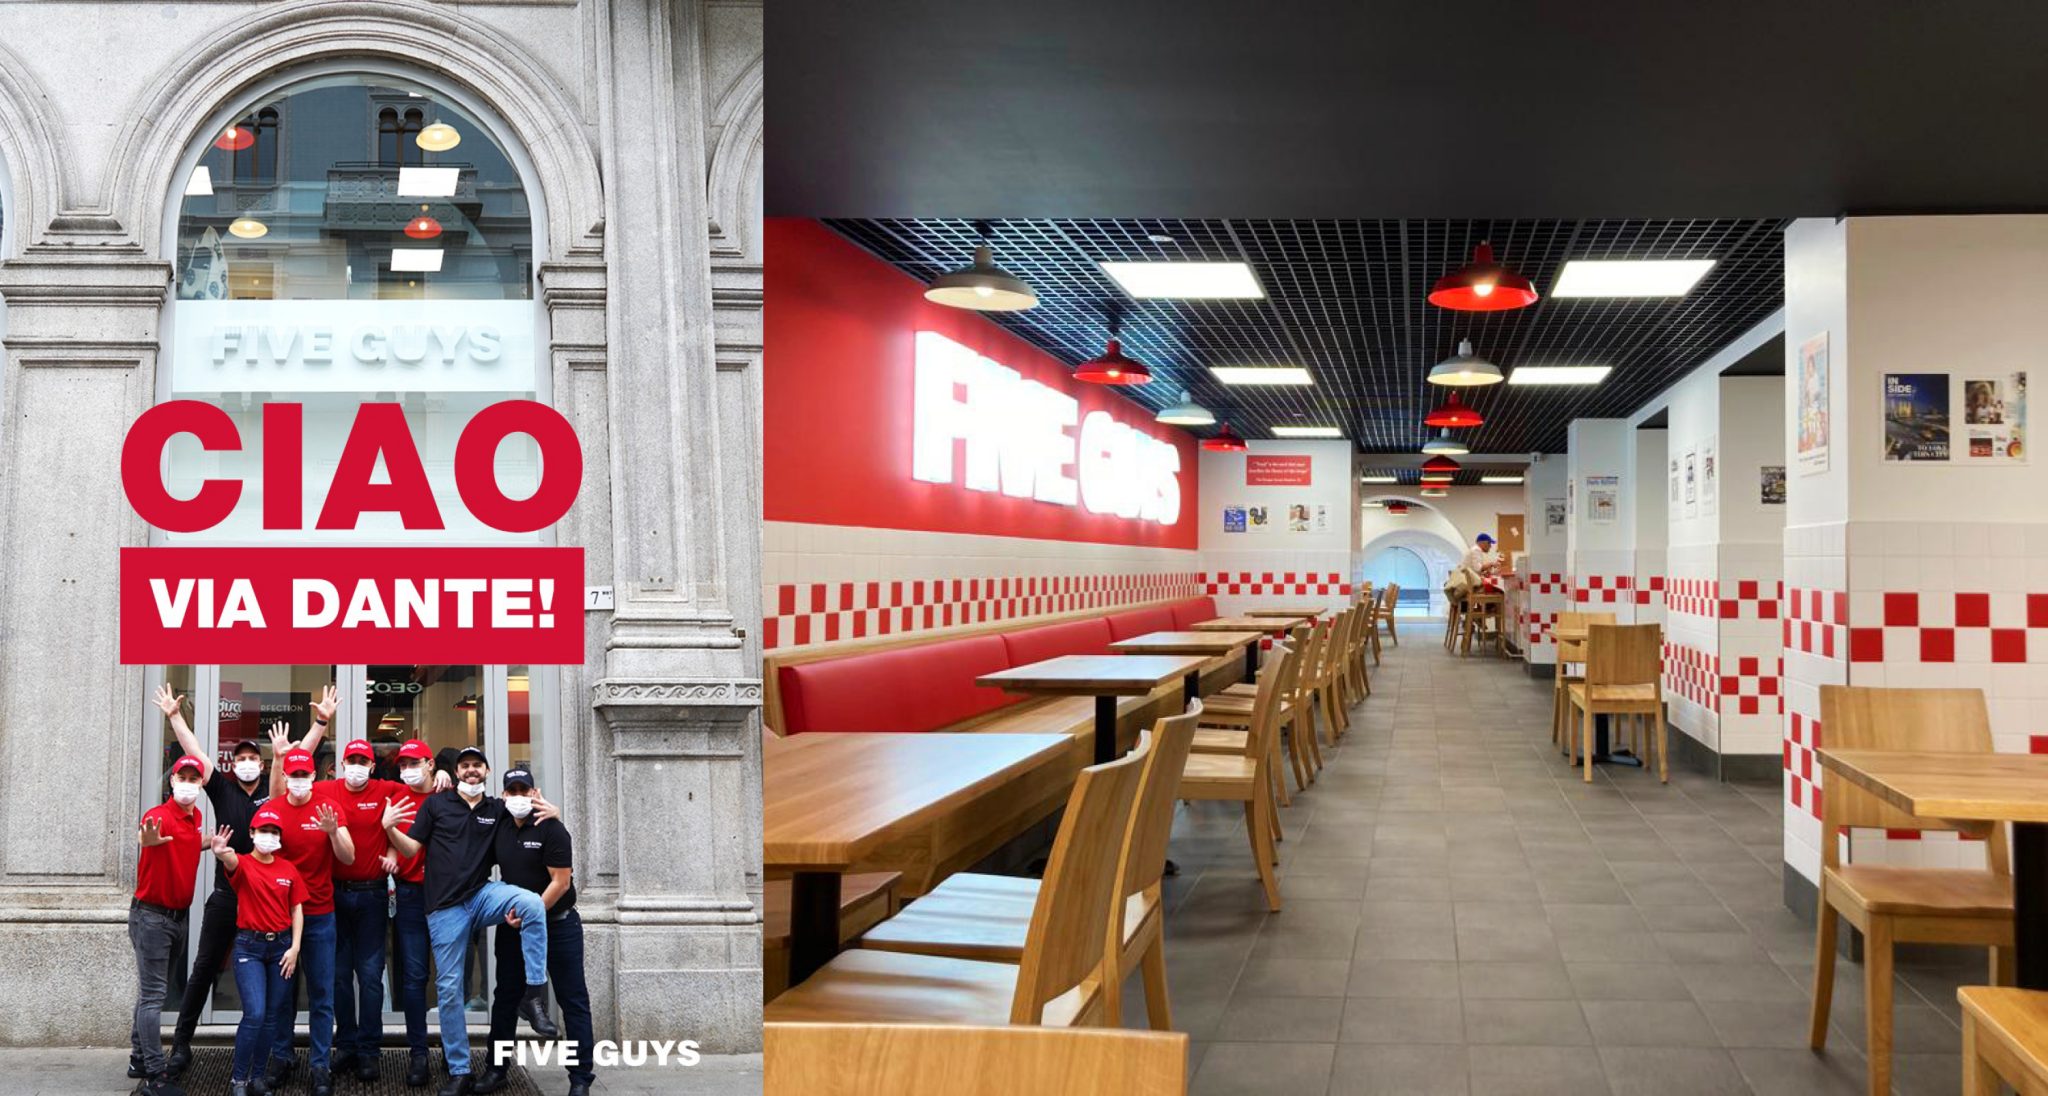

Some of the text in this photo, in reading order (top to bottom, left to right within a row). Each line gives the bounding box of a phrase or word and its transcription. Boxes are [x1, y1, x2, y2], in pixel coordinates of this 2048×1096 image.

[212, 326, 501, 366] FIVE GUYS
[912, 331, 1079, 507] FIVE
[590, 591, 600, 605] 7
